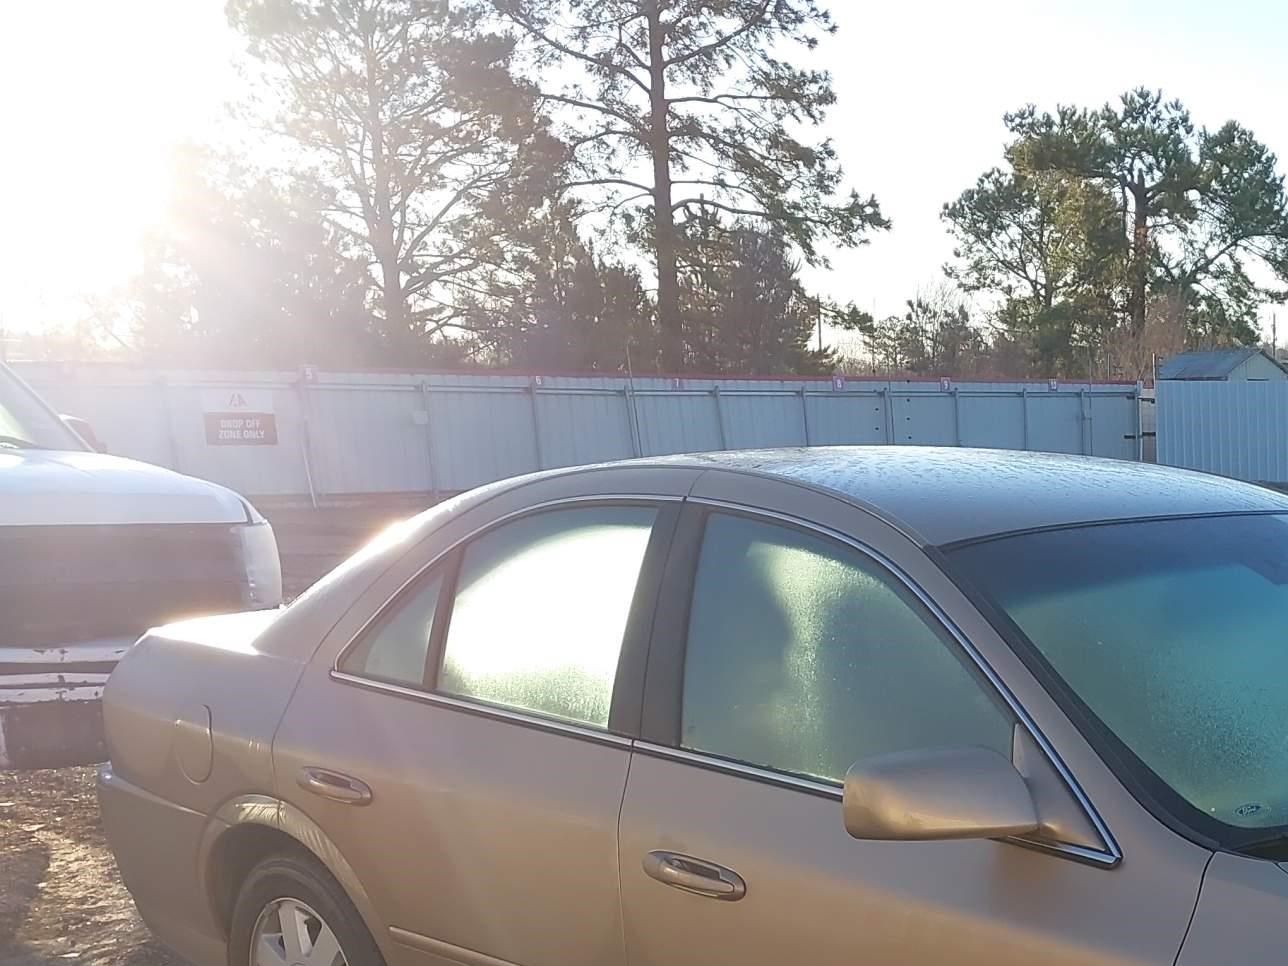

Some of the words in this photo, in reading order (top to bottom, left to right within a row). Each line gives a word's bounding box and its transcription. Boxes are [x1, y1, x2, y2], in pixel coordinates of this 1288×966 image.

[220, 419, 244, 428] DROP
[246, 419, 261, 428] OFF
[218, 430, 242, 439] ZONE
[243, 430, 265, 439] ONLY
